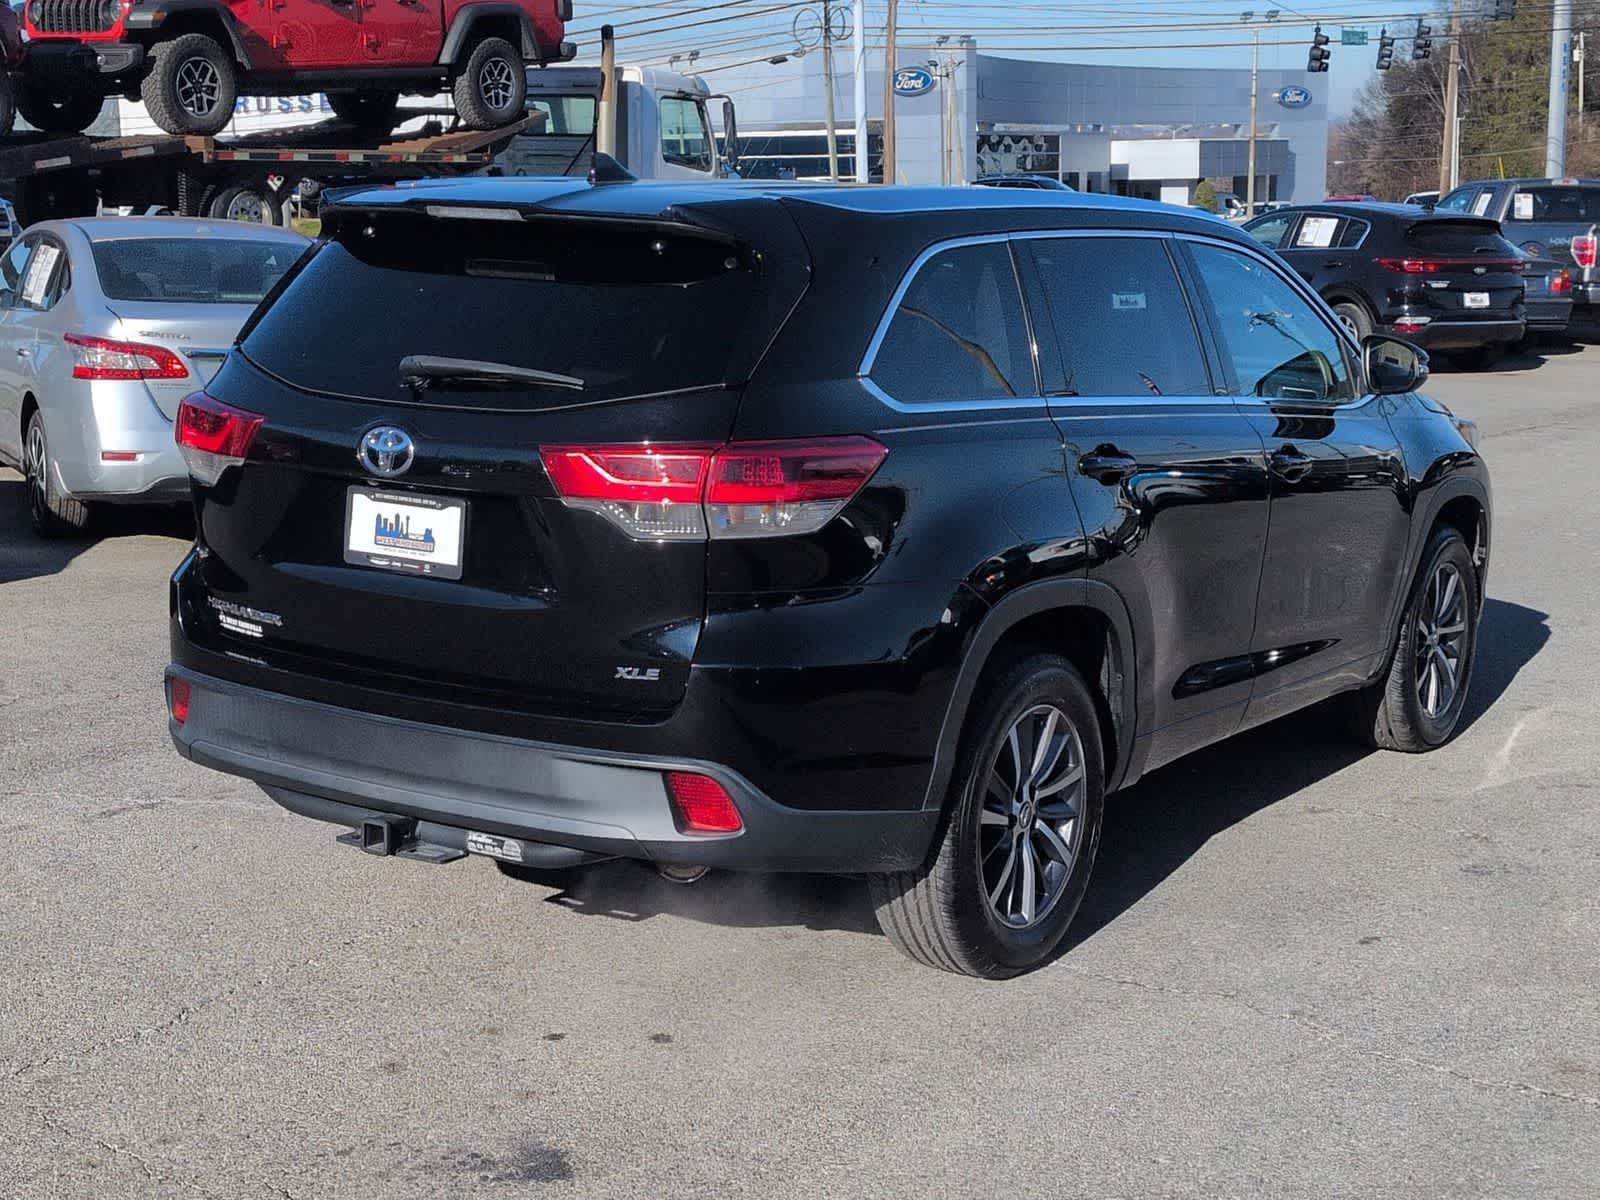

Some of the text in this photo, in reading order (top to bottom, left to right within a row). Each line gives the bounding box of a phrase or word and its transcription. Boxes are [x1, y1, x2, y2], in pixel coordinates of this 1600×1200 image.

[896, 71, 925, 89] Ford
[1284, 88, 1306, 103] Ford
[614, 666, 660, 681] XLE
